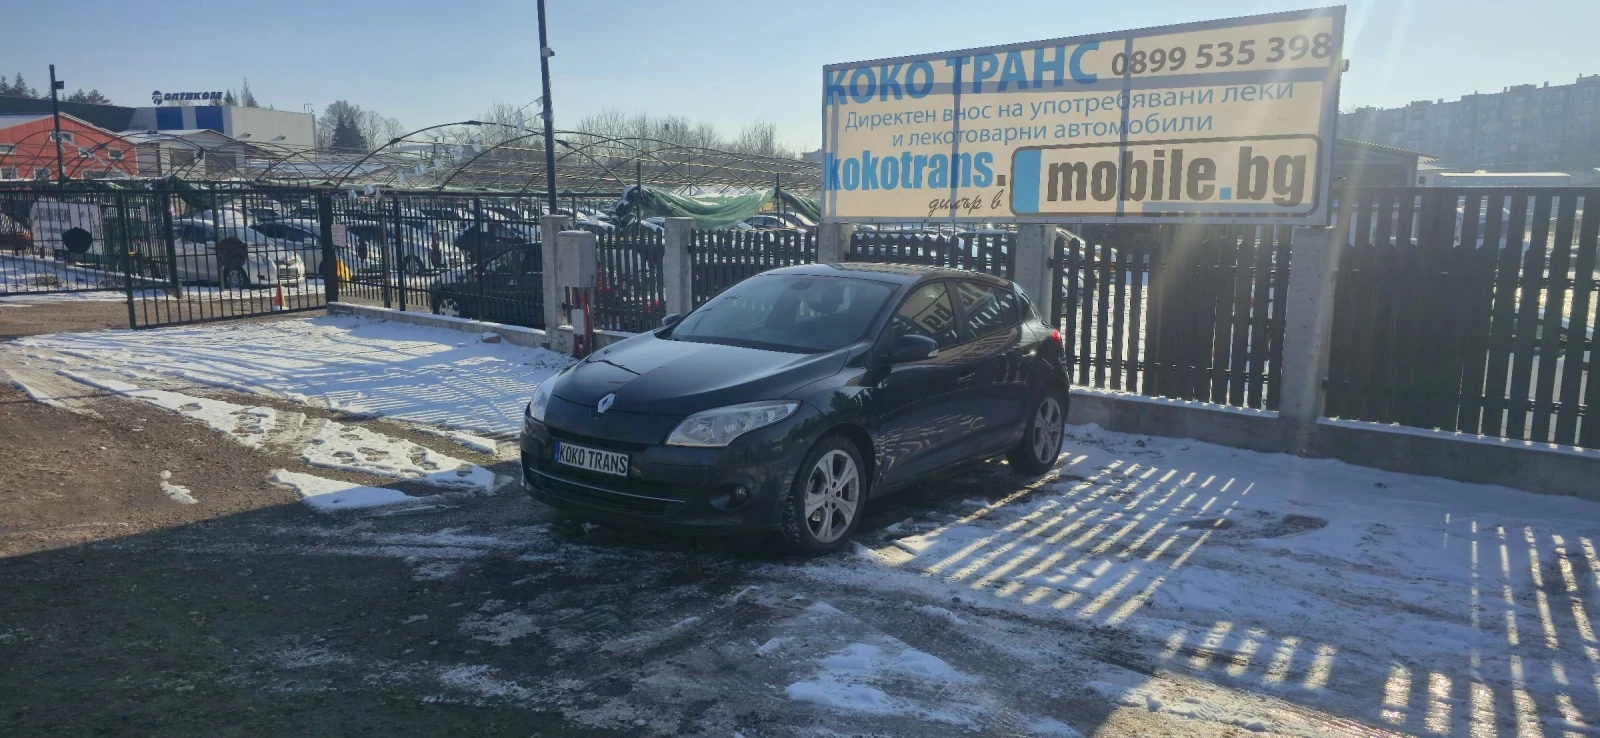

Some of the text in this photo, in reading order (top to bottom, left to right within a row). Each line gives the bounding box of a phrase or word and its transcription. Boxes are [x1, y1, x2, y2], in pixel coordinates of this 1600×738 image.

[826, 41, 1100, 106] КОКО ТРАНС
[1111, 32, 1333, 76] 0899 535 398
[163, 91, 223, 101] ОПТИКОМ
[845, 82, 1294, 132] Директен внос на употребявани леки
[892, 112, 1213, 147] и лекотоварни автомобили
[1047, 146, 1307, 207] mobile.bg
[928, 188, 1004, 217] дилър в
[560, 444, 628, 474] KOKO TRANS
